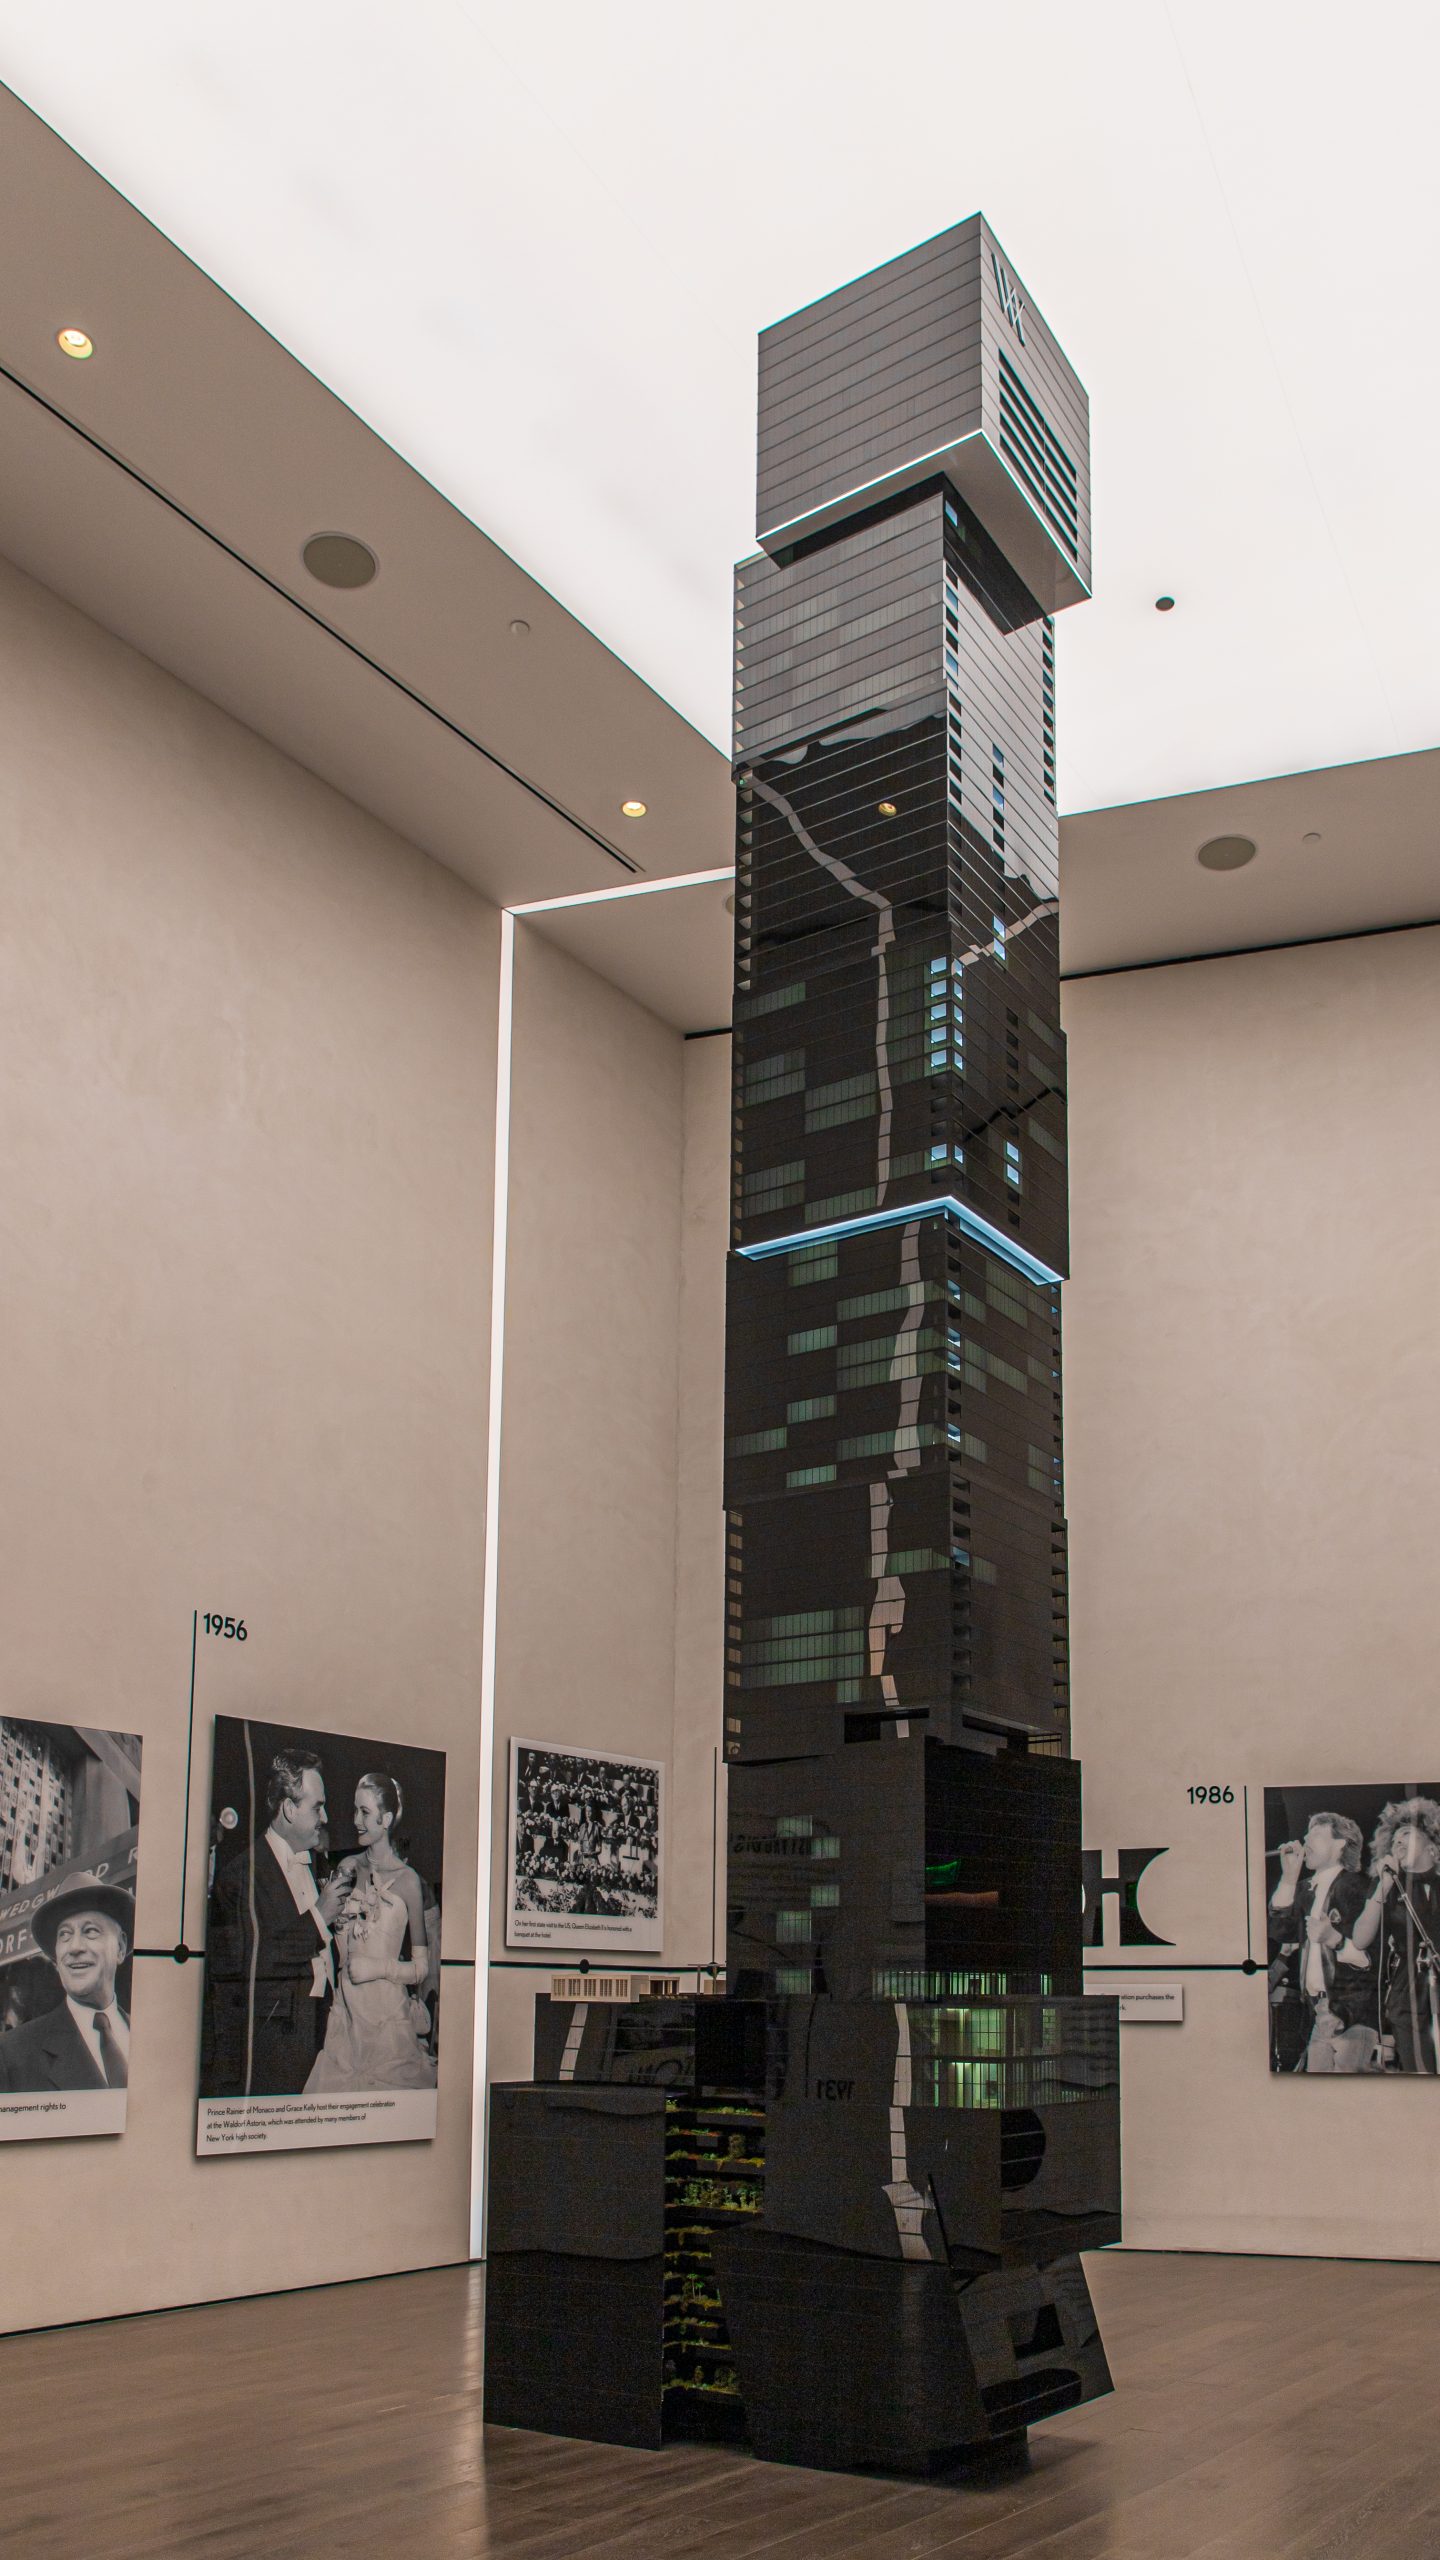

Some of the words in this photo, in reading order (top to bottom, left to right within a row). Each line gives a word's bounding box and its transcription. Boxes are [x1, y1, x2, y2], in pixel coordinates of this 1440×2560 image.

[203, 1613, 247, 1641] 1956
[1187, 1785, 1234, 1804] 1986
[1136, 1993, 1164, 2001] purchases
[40, 2102, 58, 2112] rights
[59, 2102, 67, 2110] to
[207, 2107, 225, 2116] Prince
[226, 2106, 245, 2116] Rainier
[246, 2105, 252, 2115] of
[252, 2105, 274, 2114] Monaco
[275, 2104, 286, 2113] and
[286, 2104, 303, 2112] Grace
[303, 2103, 316, 2112] Kelly
[316, 2103, 327, 2111] host
[327, 2102, 339, 2110] their
[340, 2102, 370, 2111] engagement
[370, 2100, 395, 2109] celebration
[206, 2121, 213, 2130] at
[213, 2120, 222, 2129] the
[223, 2119, 246, 2128] Waldorf
[246, 2119, 267, 2127] Astoria,
[268, 2117, 282, 2126] which
[294, 2116, 317, 2124] attended
[317, 2115, 323, 2124] by
[338, 2114, 360, 2122] members
[206, 2134, 220, 2142] New
[221, 2133, 234, 2142] York
[235, 2133, 247, 2143] high
